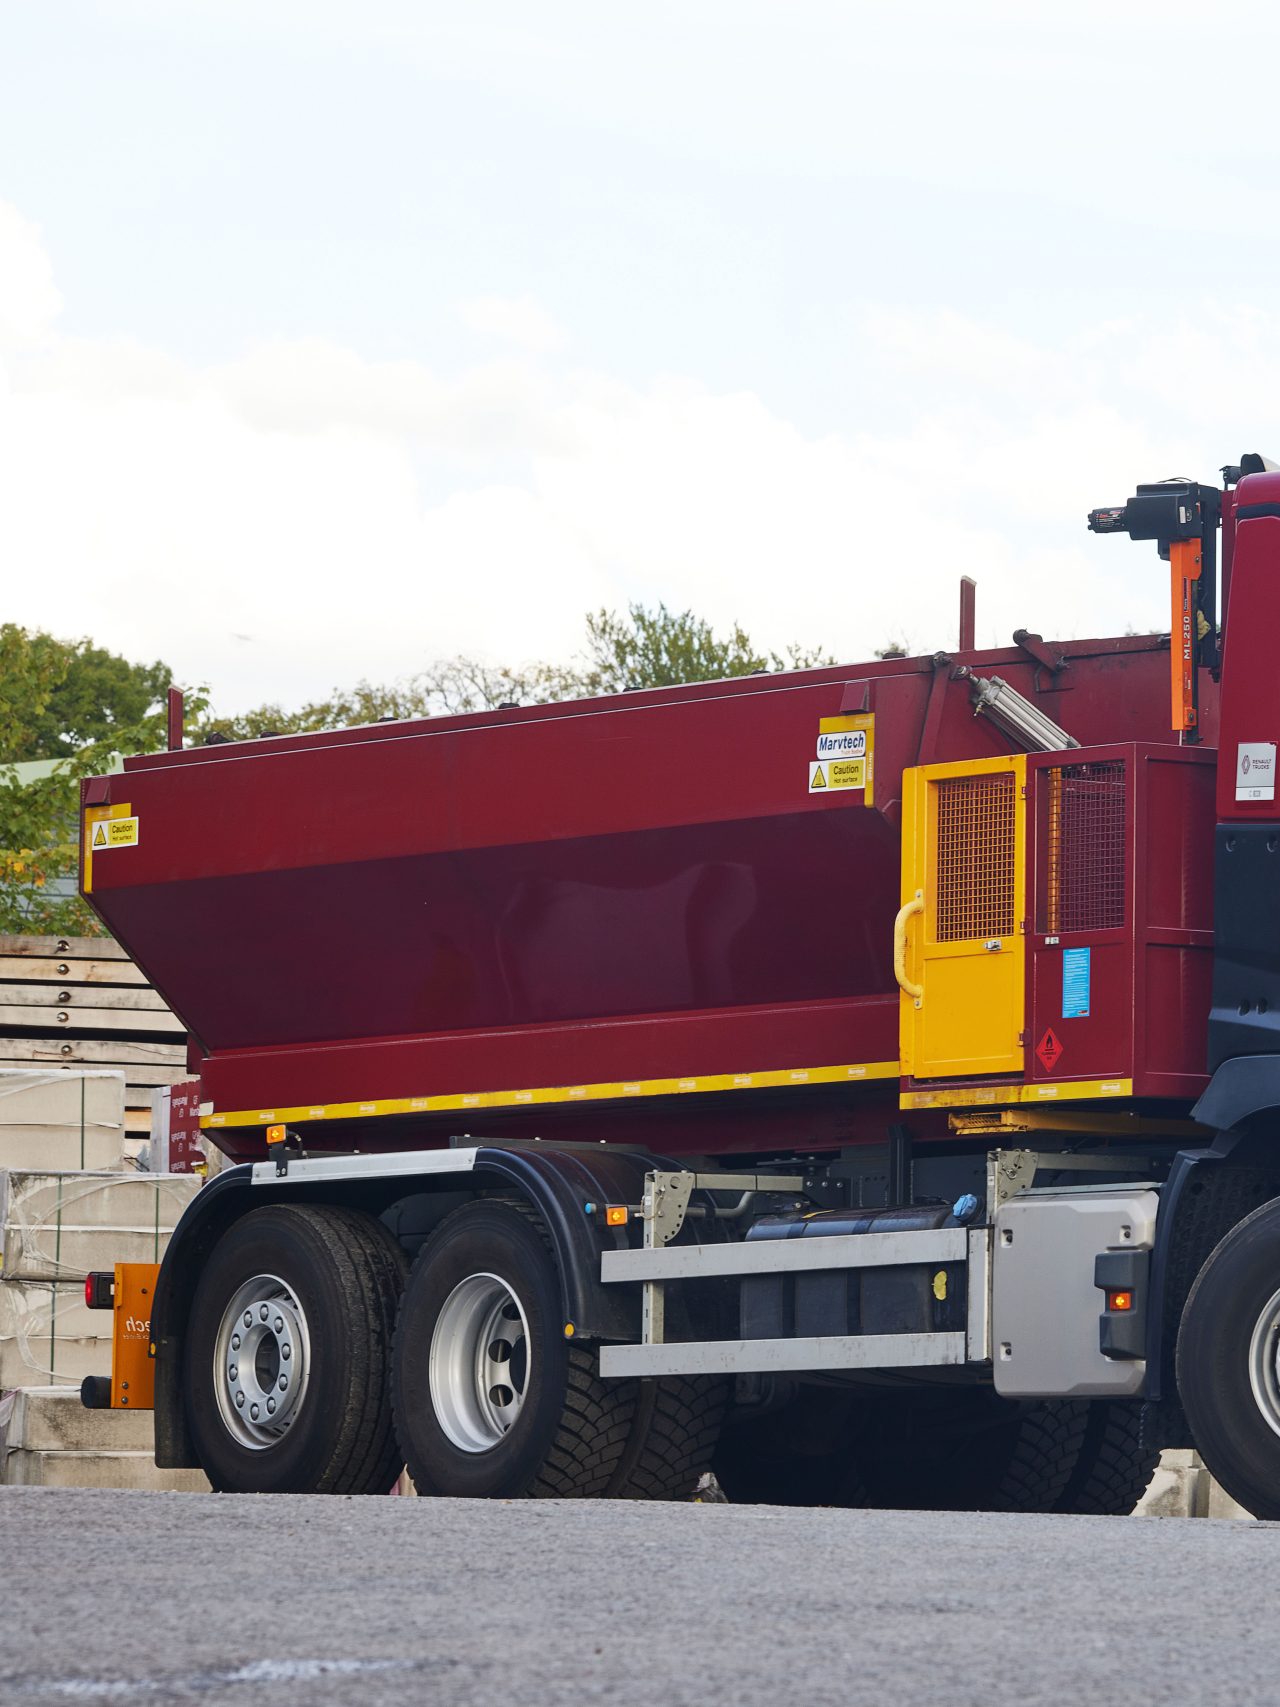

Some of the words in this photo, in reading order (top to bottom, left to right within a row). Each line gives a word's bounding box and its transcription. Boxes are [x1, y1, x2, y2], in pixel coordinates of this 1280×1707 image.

[819, 733, 864, 752] Marvtech
[833, 765, 859, 775] Caution
[111, 823, 133, 834] Caution
